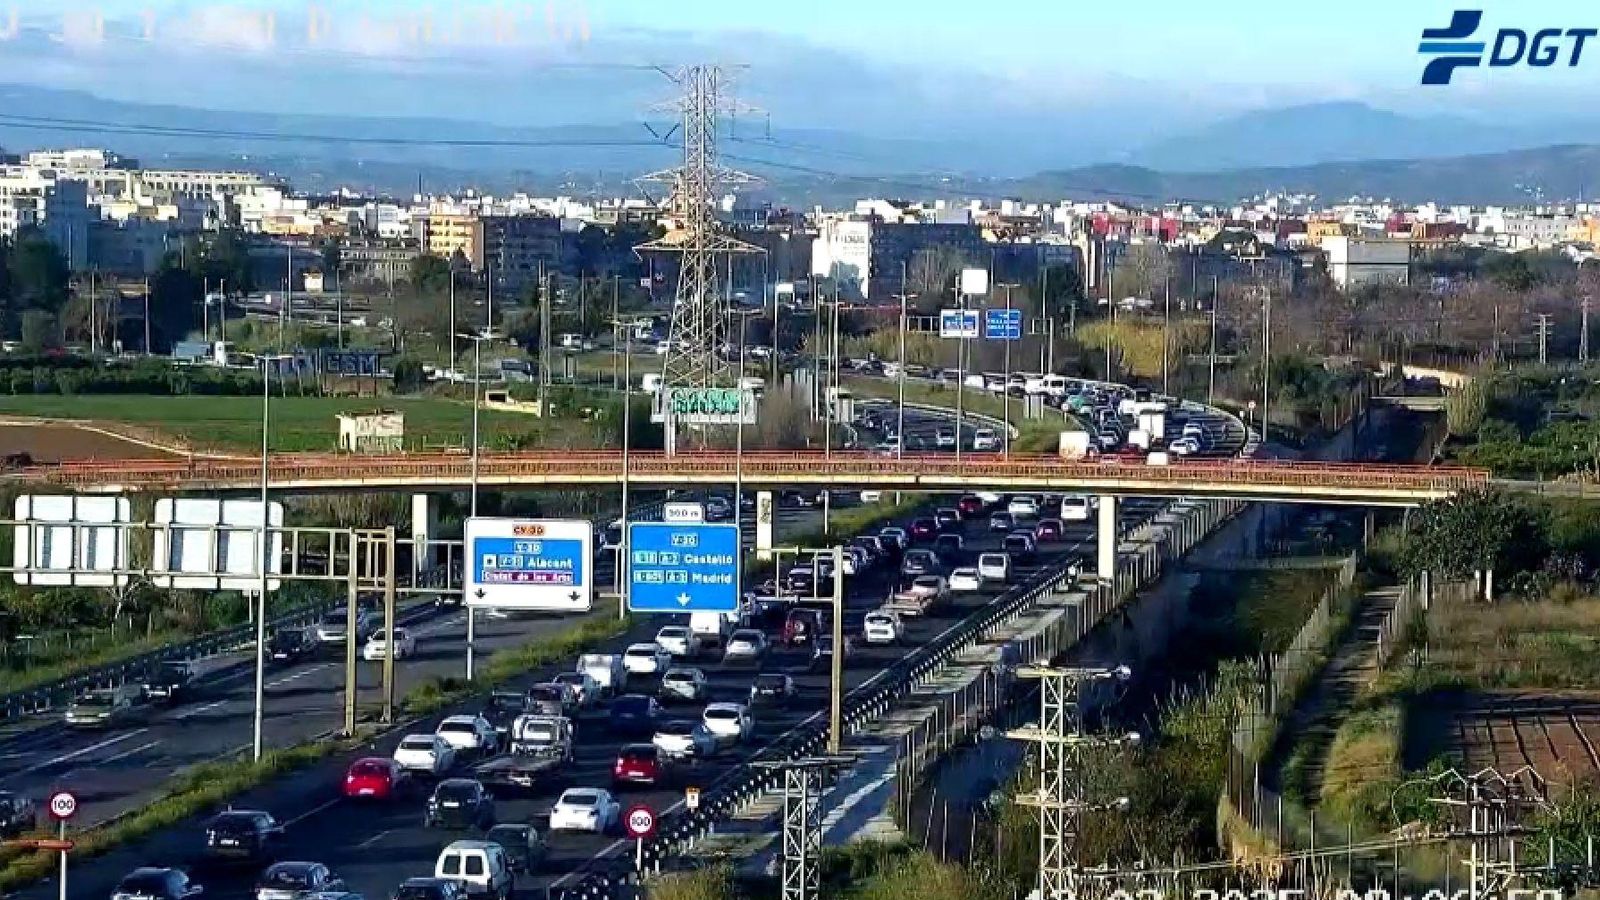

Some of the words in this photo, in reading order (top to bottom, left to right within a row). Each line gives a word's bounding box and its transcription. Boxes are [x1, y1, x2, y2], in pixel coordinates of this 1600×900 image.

[528, 556, 572, 569] Alacant
[692, 572, 732, 584] Madrid
[54, 800, 73, 810] 100
[631, 816, 651, 826] 100
